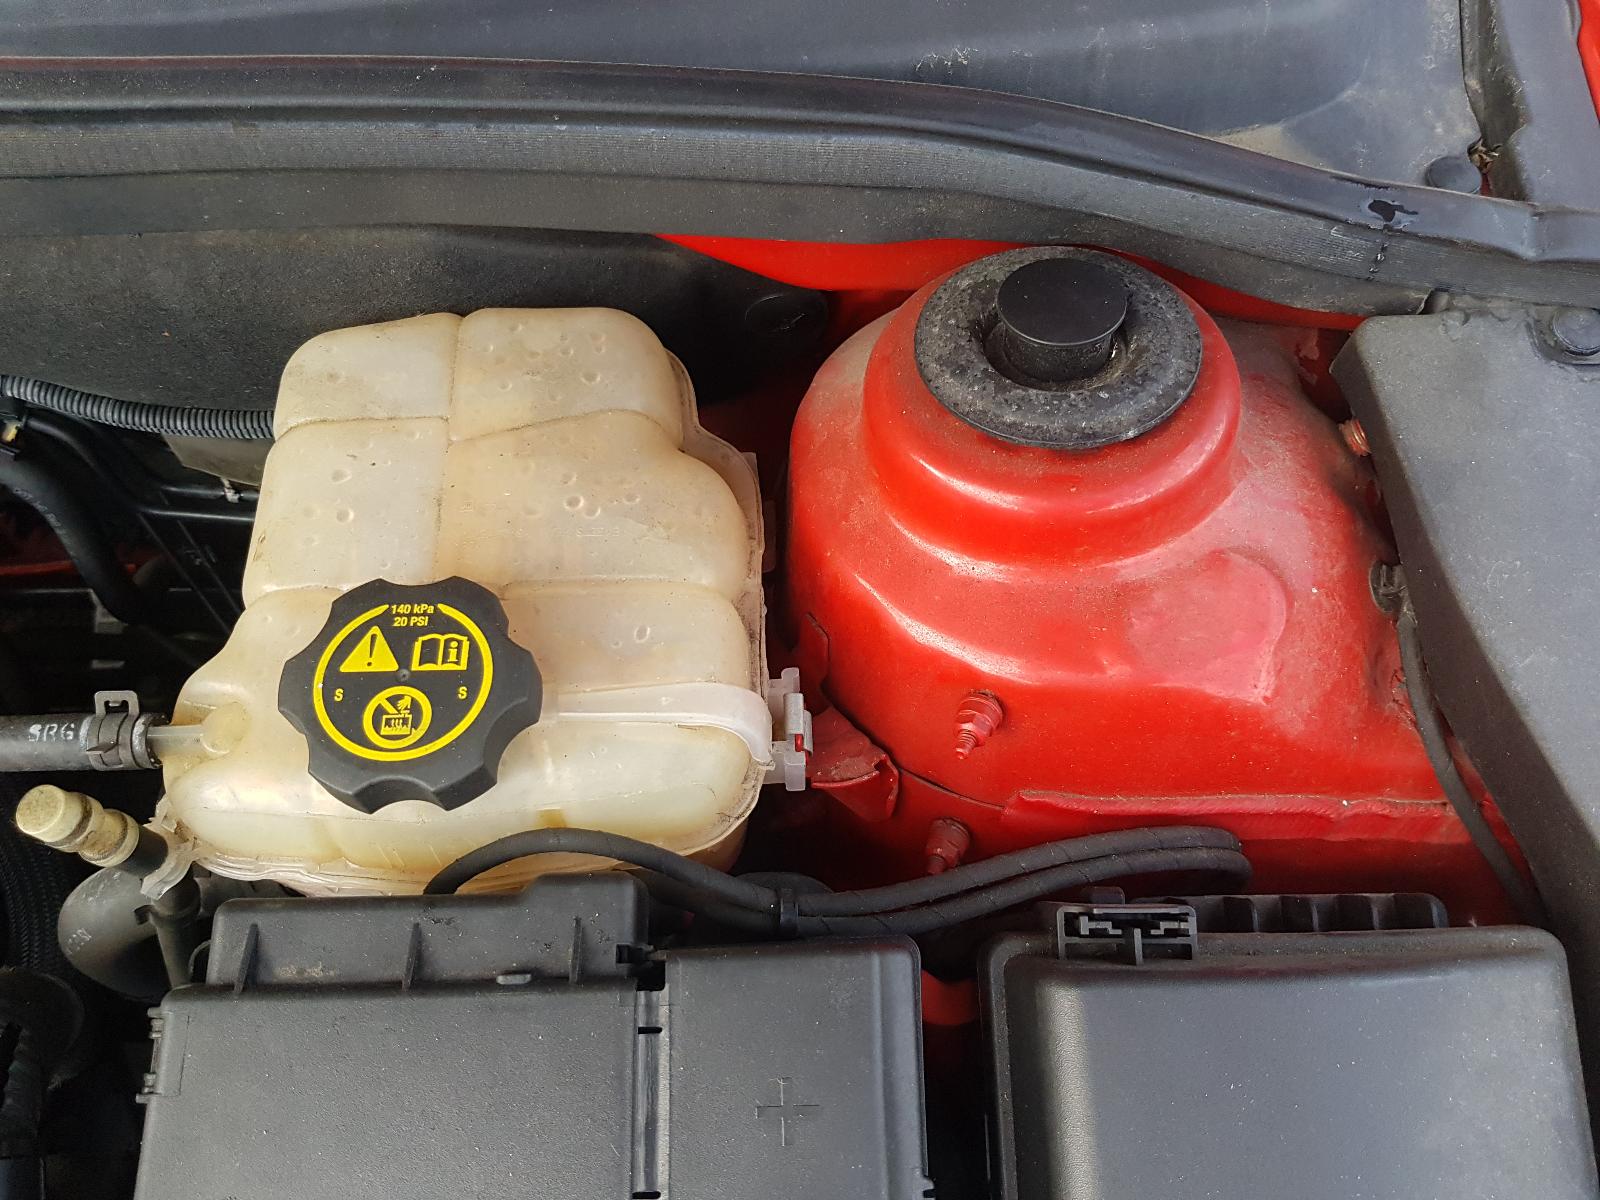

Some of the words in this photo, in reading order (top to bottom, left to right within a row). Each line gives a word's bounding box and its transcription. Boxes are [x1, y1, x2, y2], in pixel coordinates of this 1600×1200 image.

[391, 604, 411, 614] 140
[413, 603, 435, 614] kPa
[392, 616, 408, 627] 20
[410, 616, 429, 627] PSI
[334, 688, 344, 702] S
[458, 686, 468, 700] S
